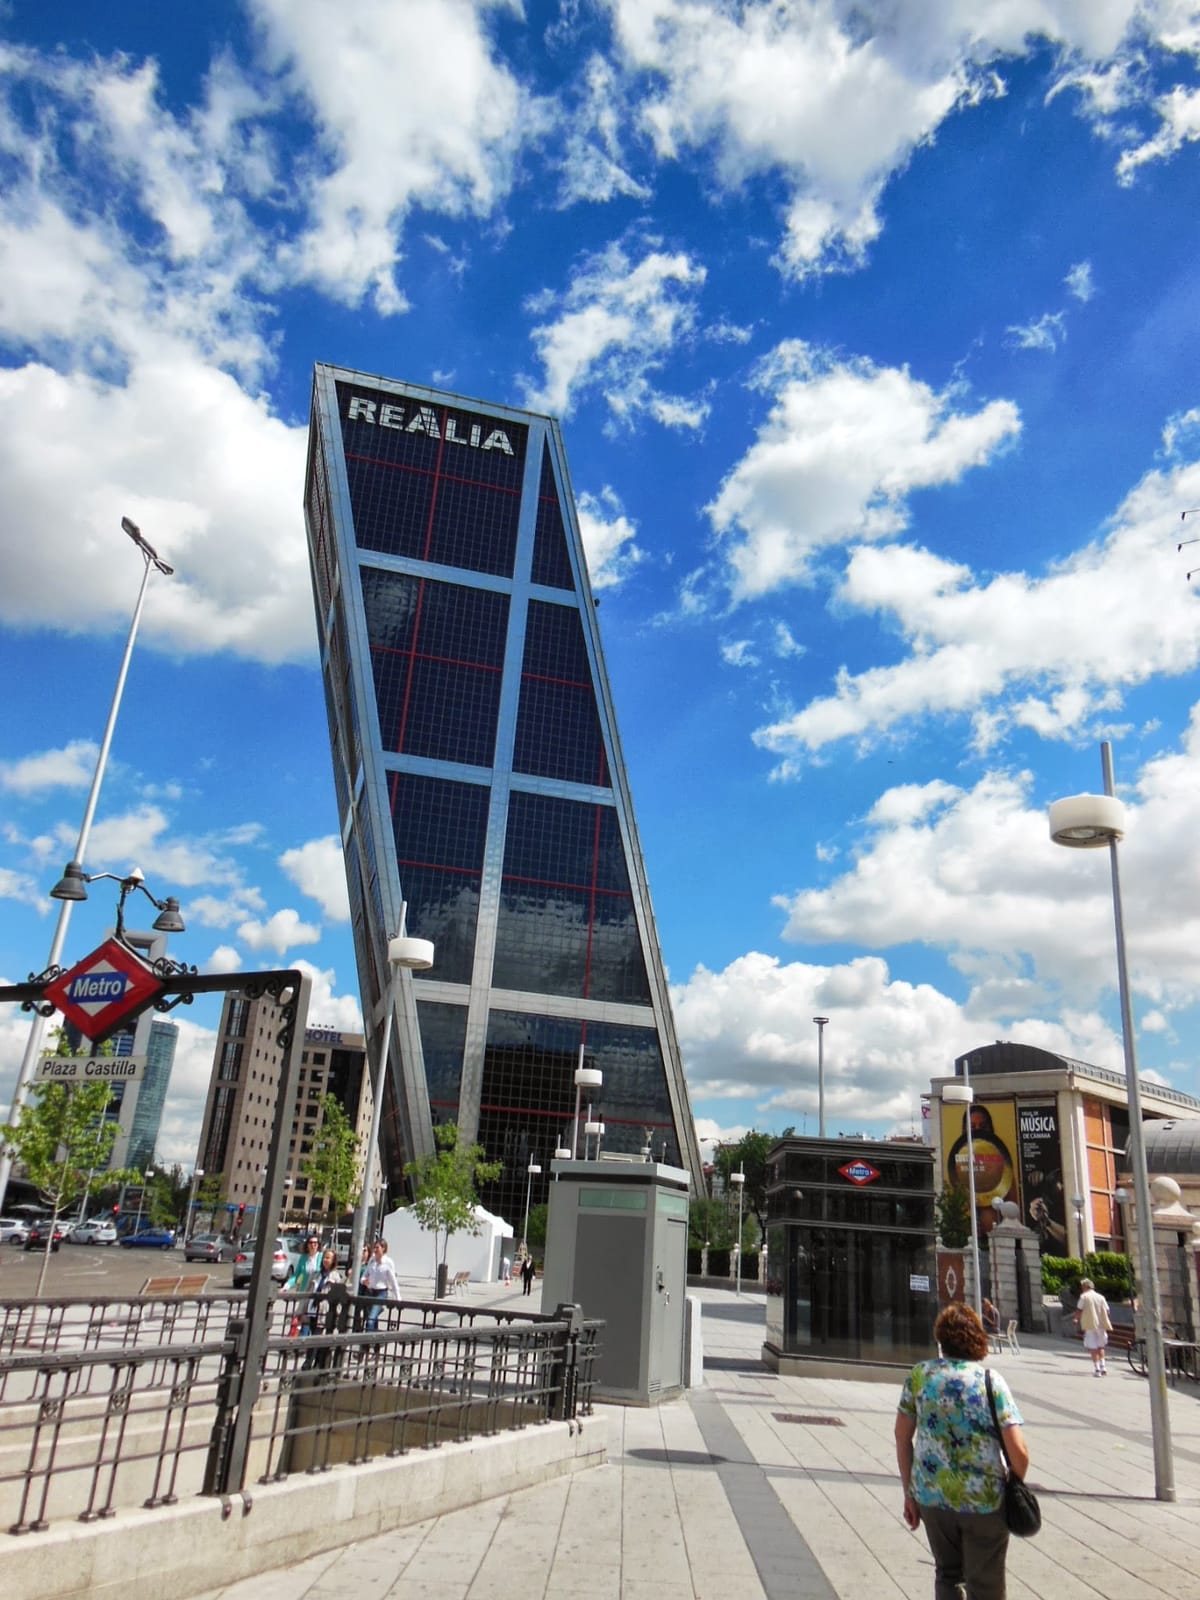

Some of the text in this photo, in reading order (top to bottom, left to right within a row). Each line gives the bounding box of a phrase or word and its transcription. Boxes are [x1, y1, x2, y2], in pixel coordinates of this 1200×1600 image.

[347, 396, 515, 456] REALIA
[73, 977, 121, 997] Metro
[42, 1060, 137, 1076] Plaza Castilla
[1020, 1114, 1056, 1132] MÚSICA
[849, 1167, 870, 1176] Metro
